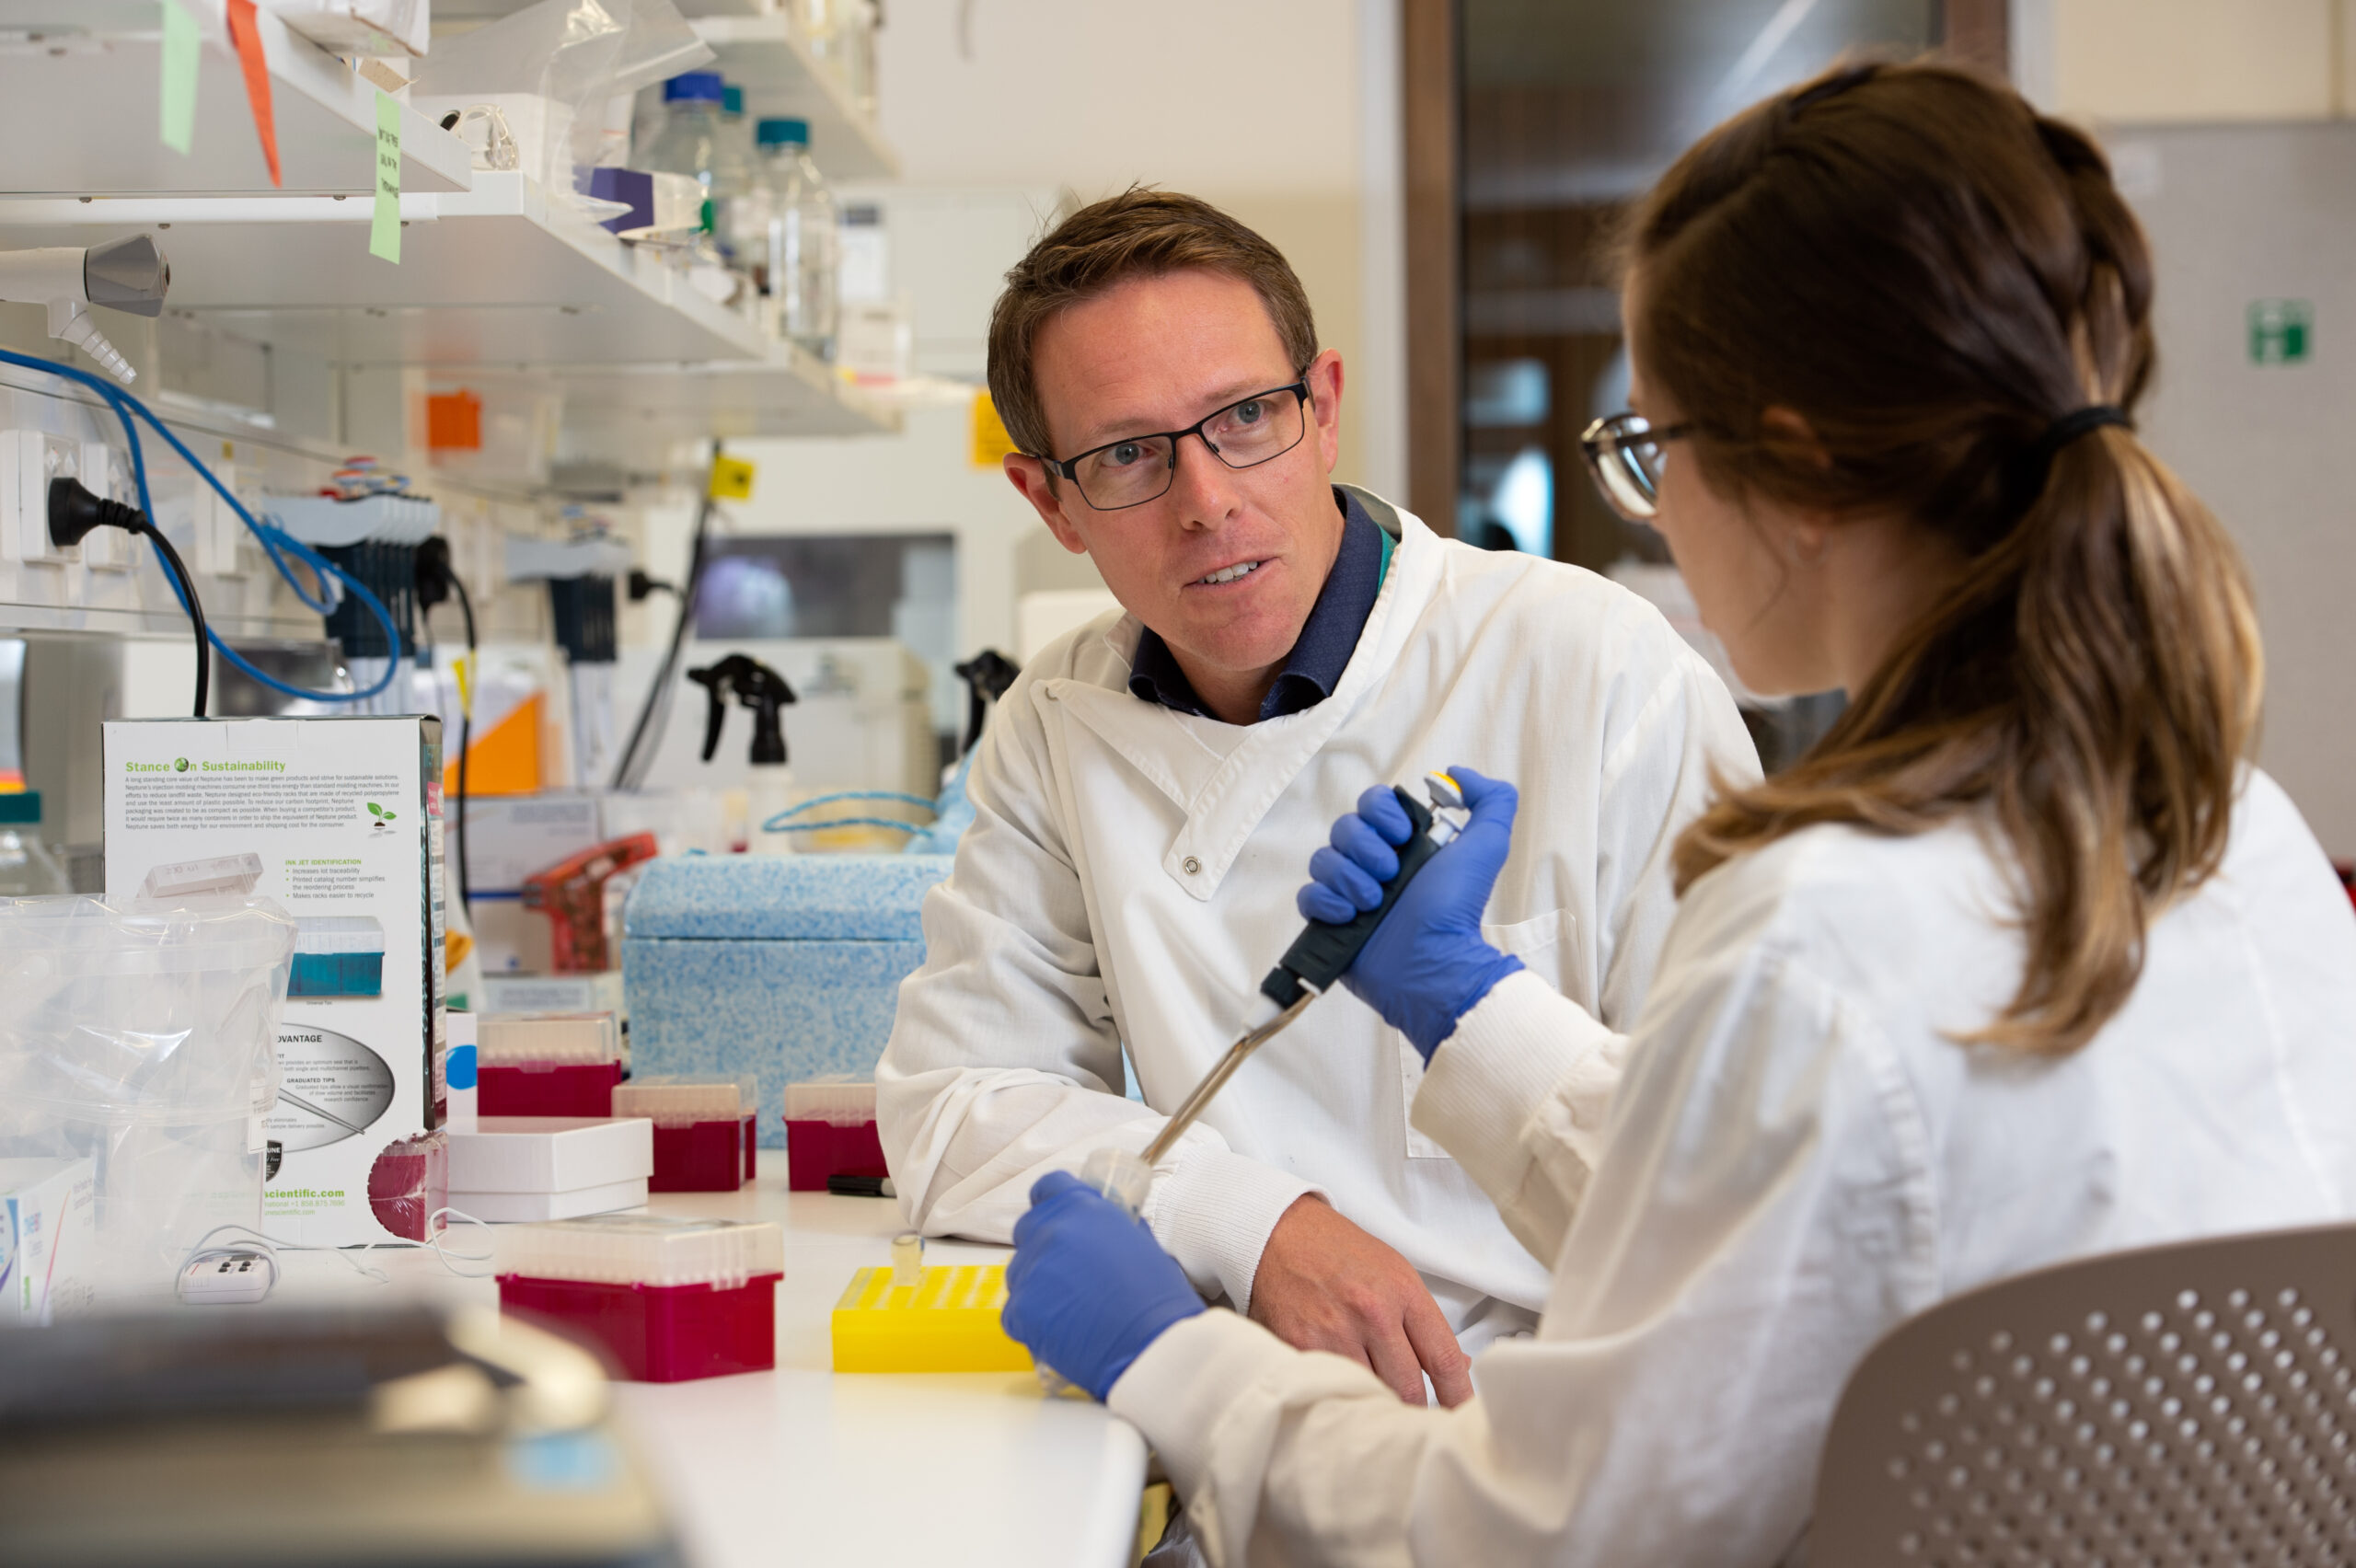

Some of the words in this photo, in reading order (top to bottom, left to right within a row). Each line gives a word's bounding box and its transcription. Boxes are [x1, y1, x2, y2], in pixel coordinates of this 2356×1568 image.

[126, 762, 170, 771] Stance
[202, 760, 286, 773] Sustainability
[265, 1189, 344, 1198] scientific.com
